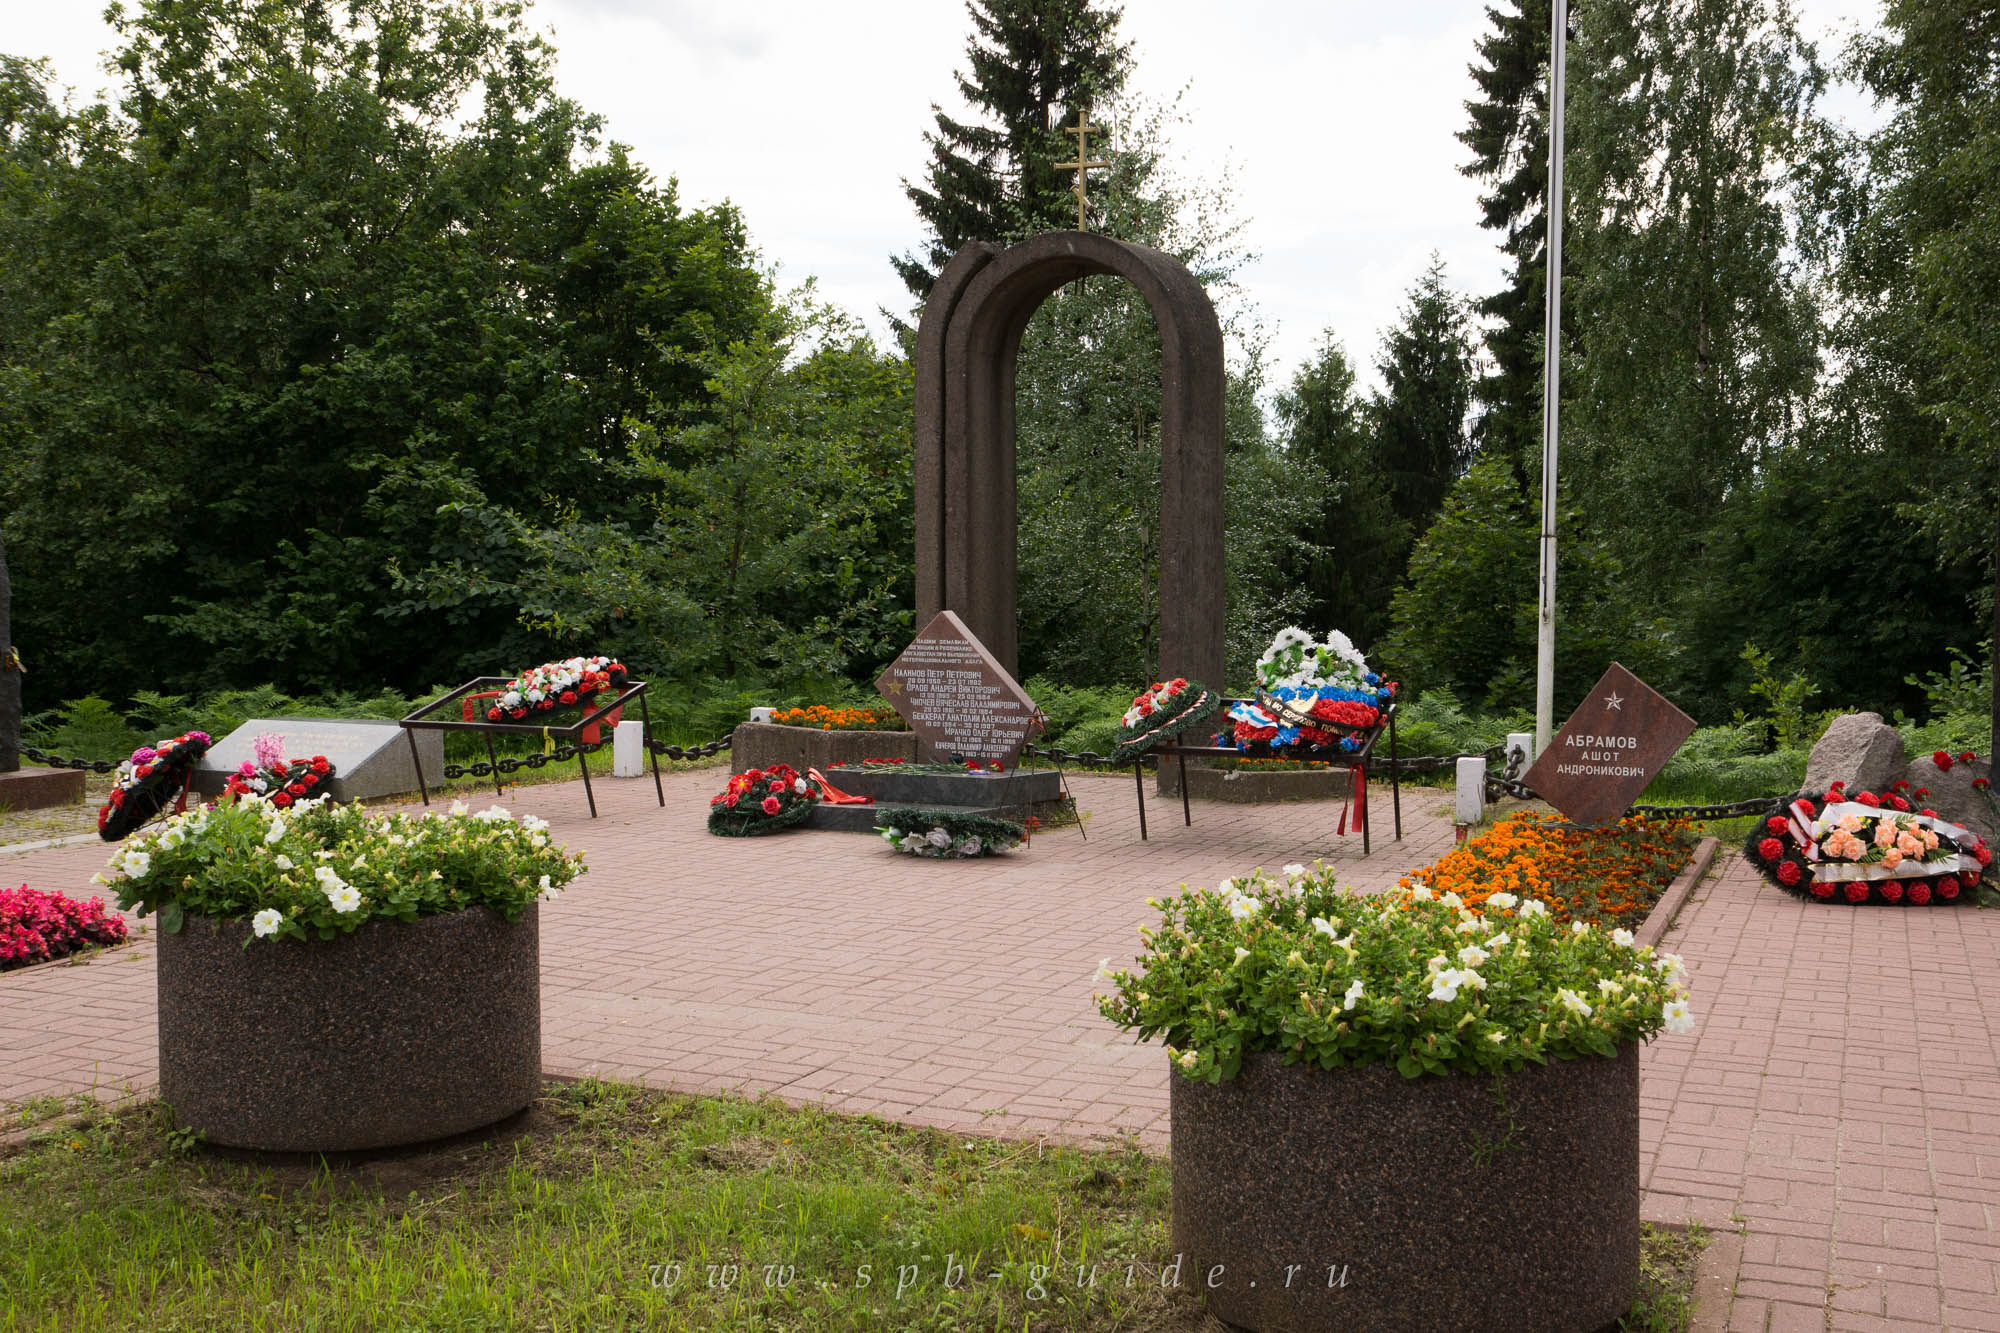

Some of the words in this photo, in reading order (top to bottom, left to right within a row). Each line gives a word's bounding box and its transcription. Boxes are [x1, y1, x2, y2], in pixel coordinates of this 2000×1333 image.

[894, 668, 925, 677] НАЛИМОВ
[927, 669, 945, 678] ПЕТР
[946, 670, 982, 679] ПЕТРОВИЧ
[906, 684, 928, 692] ОРЛОВ
[958, 685, 1001, 694] ВИКТОРОВИЧ
[936, 698, 969, 707] ВЯЧЕСЛАВ
[971, 700, 1020, 709] ВЛАДИМИРОВИЧ
[945, 727, 971, 736] МРАЧКО
[973, 729, 990, 737] ОЛЕГ
[992, 729, 1024, 739] ЮРЬЕВИЧ
[957, 743, 982, 751] ВЛАДИМИР
[983, 744, 1010, 752] АЛЕКСЕЕВИЧ
[1565, 735, 1637, 749] АБРАМОВ
[1581, 751, 1620, 762] АШОТ
[1557, 764, 1644, 777] АНДРОНИКОВИЧ
